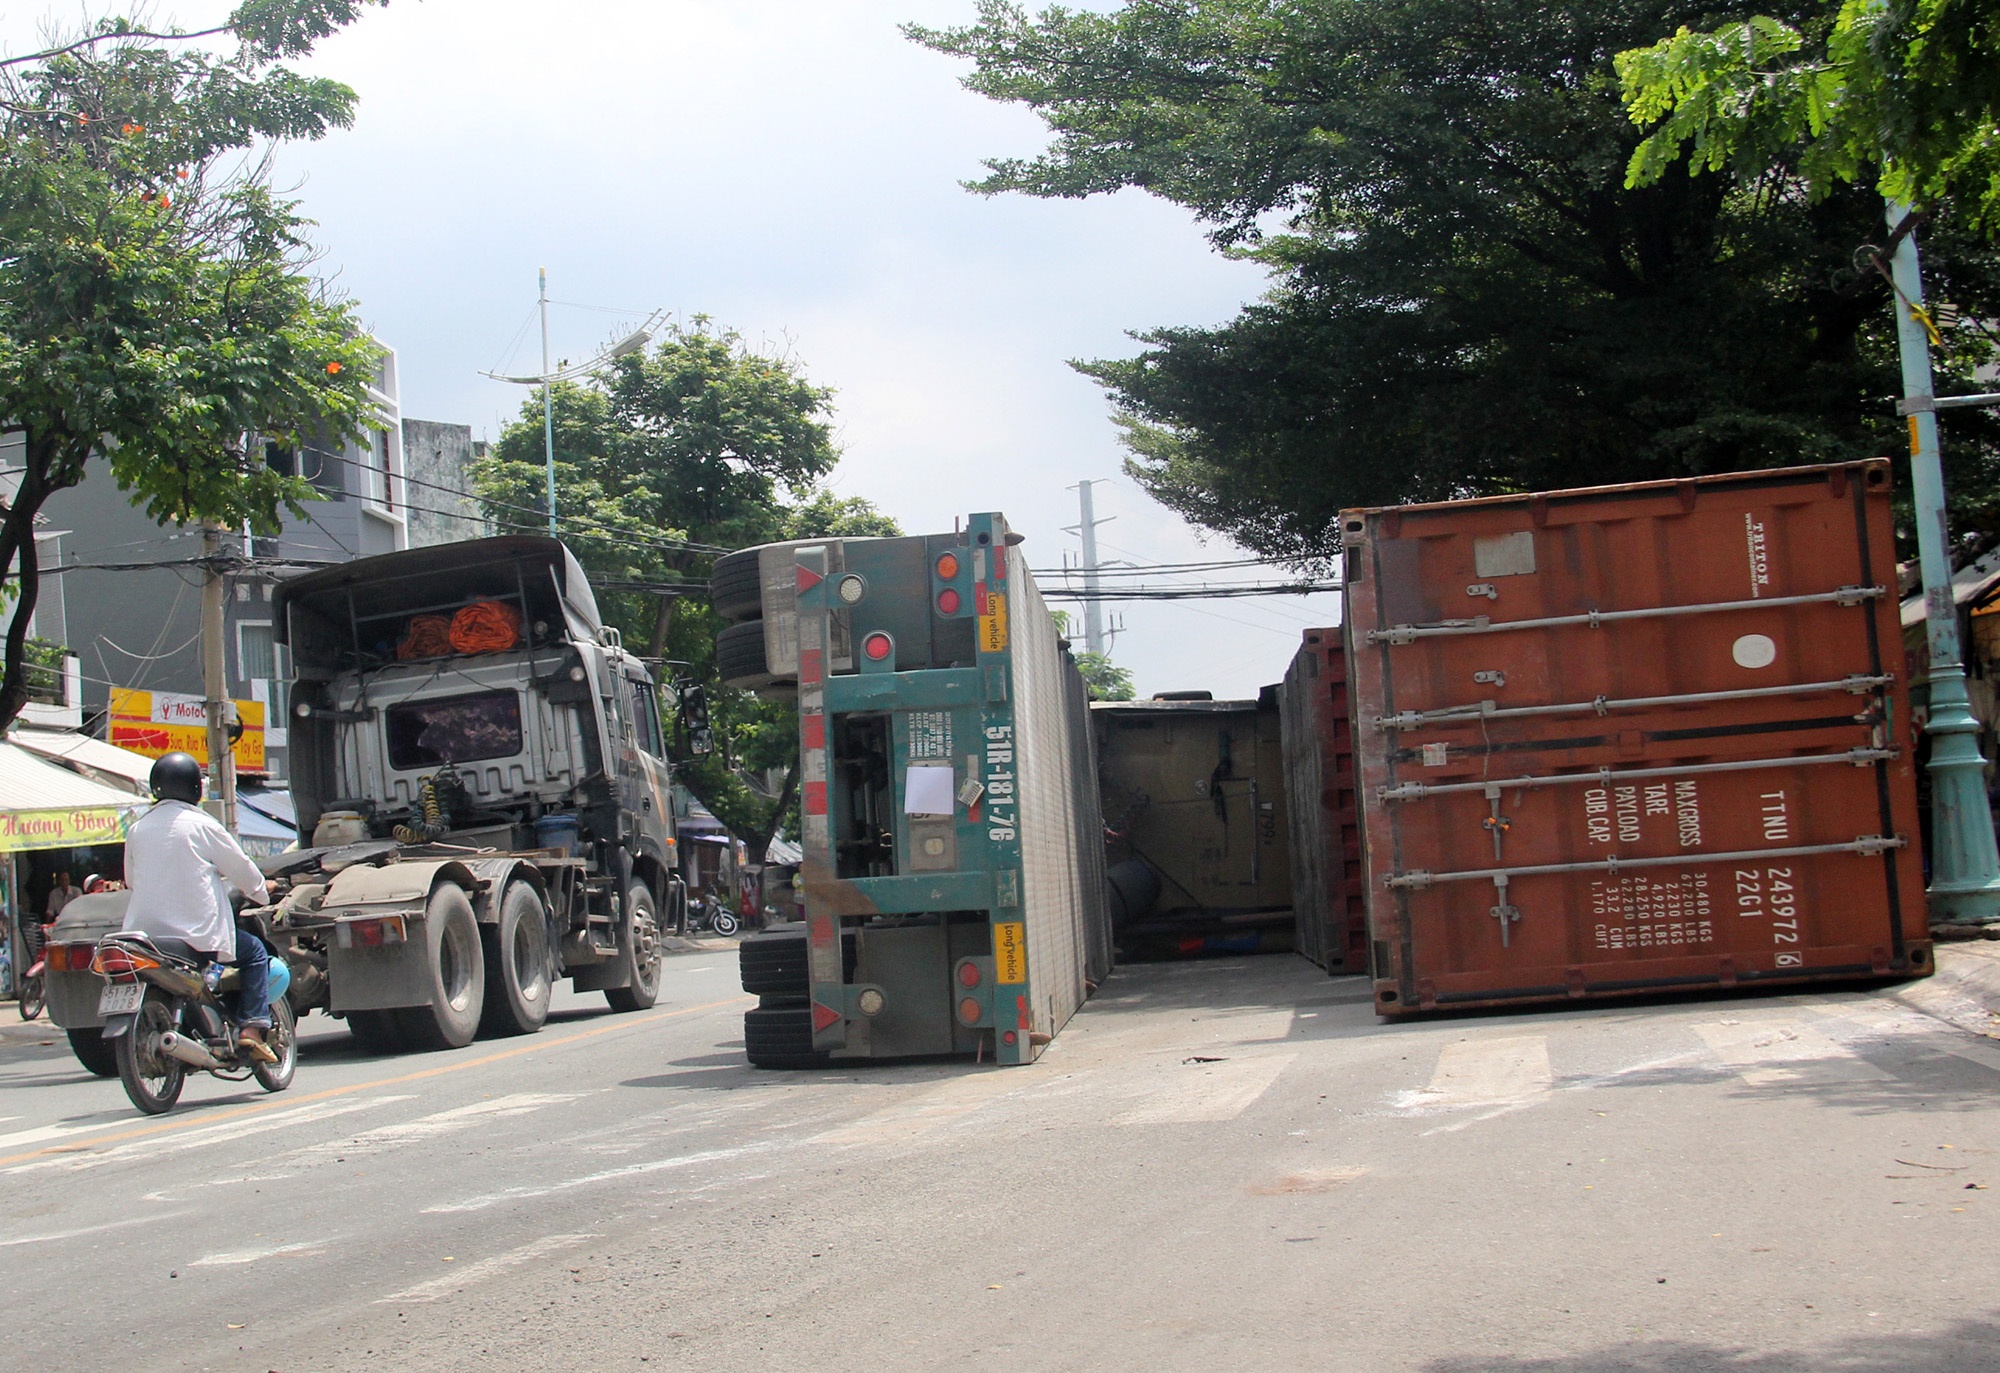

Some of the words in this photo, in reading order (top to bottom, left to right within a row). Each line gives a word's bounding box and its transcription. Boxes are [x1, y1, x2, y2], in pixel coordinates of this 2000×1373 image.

[1745, 512, 1758, 597] www.tritoncontainer.com
[1753, 523, 1768, 584] TRITON
[990, 618, 1000, 649] vehicle
[1761, 790, 1788, 840] TTNU
[1615, 786, 1640, 842] PAYLOAD
[1639, 925, 1652, 946] KGS
[1644, 783, 1669, 816] TARE
[1670, 923, 1683, 944] KGS
[1736, 870, 1763, 916] 22G1
[1768, 868, 1798, 944] 243972
[1003, 924, 1014, 947] Long
[1595, 924, 1608, 949] CUFT
[1610, 928, 1623, 949] CUM
[1625, 926, 1637, 947] LBS
[1655, 924, 1668, 945] LBS
[1685, 922, 1697, 943] LBS
[1699, 921, 1712, 942] KGS
[1007, 949, 1017, 980] vehicle
[1777, 953, 1800, 967] 6
